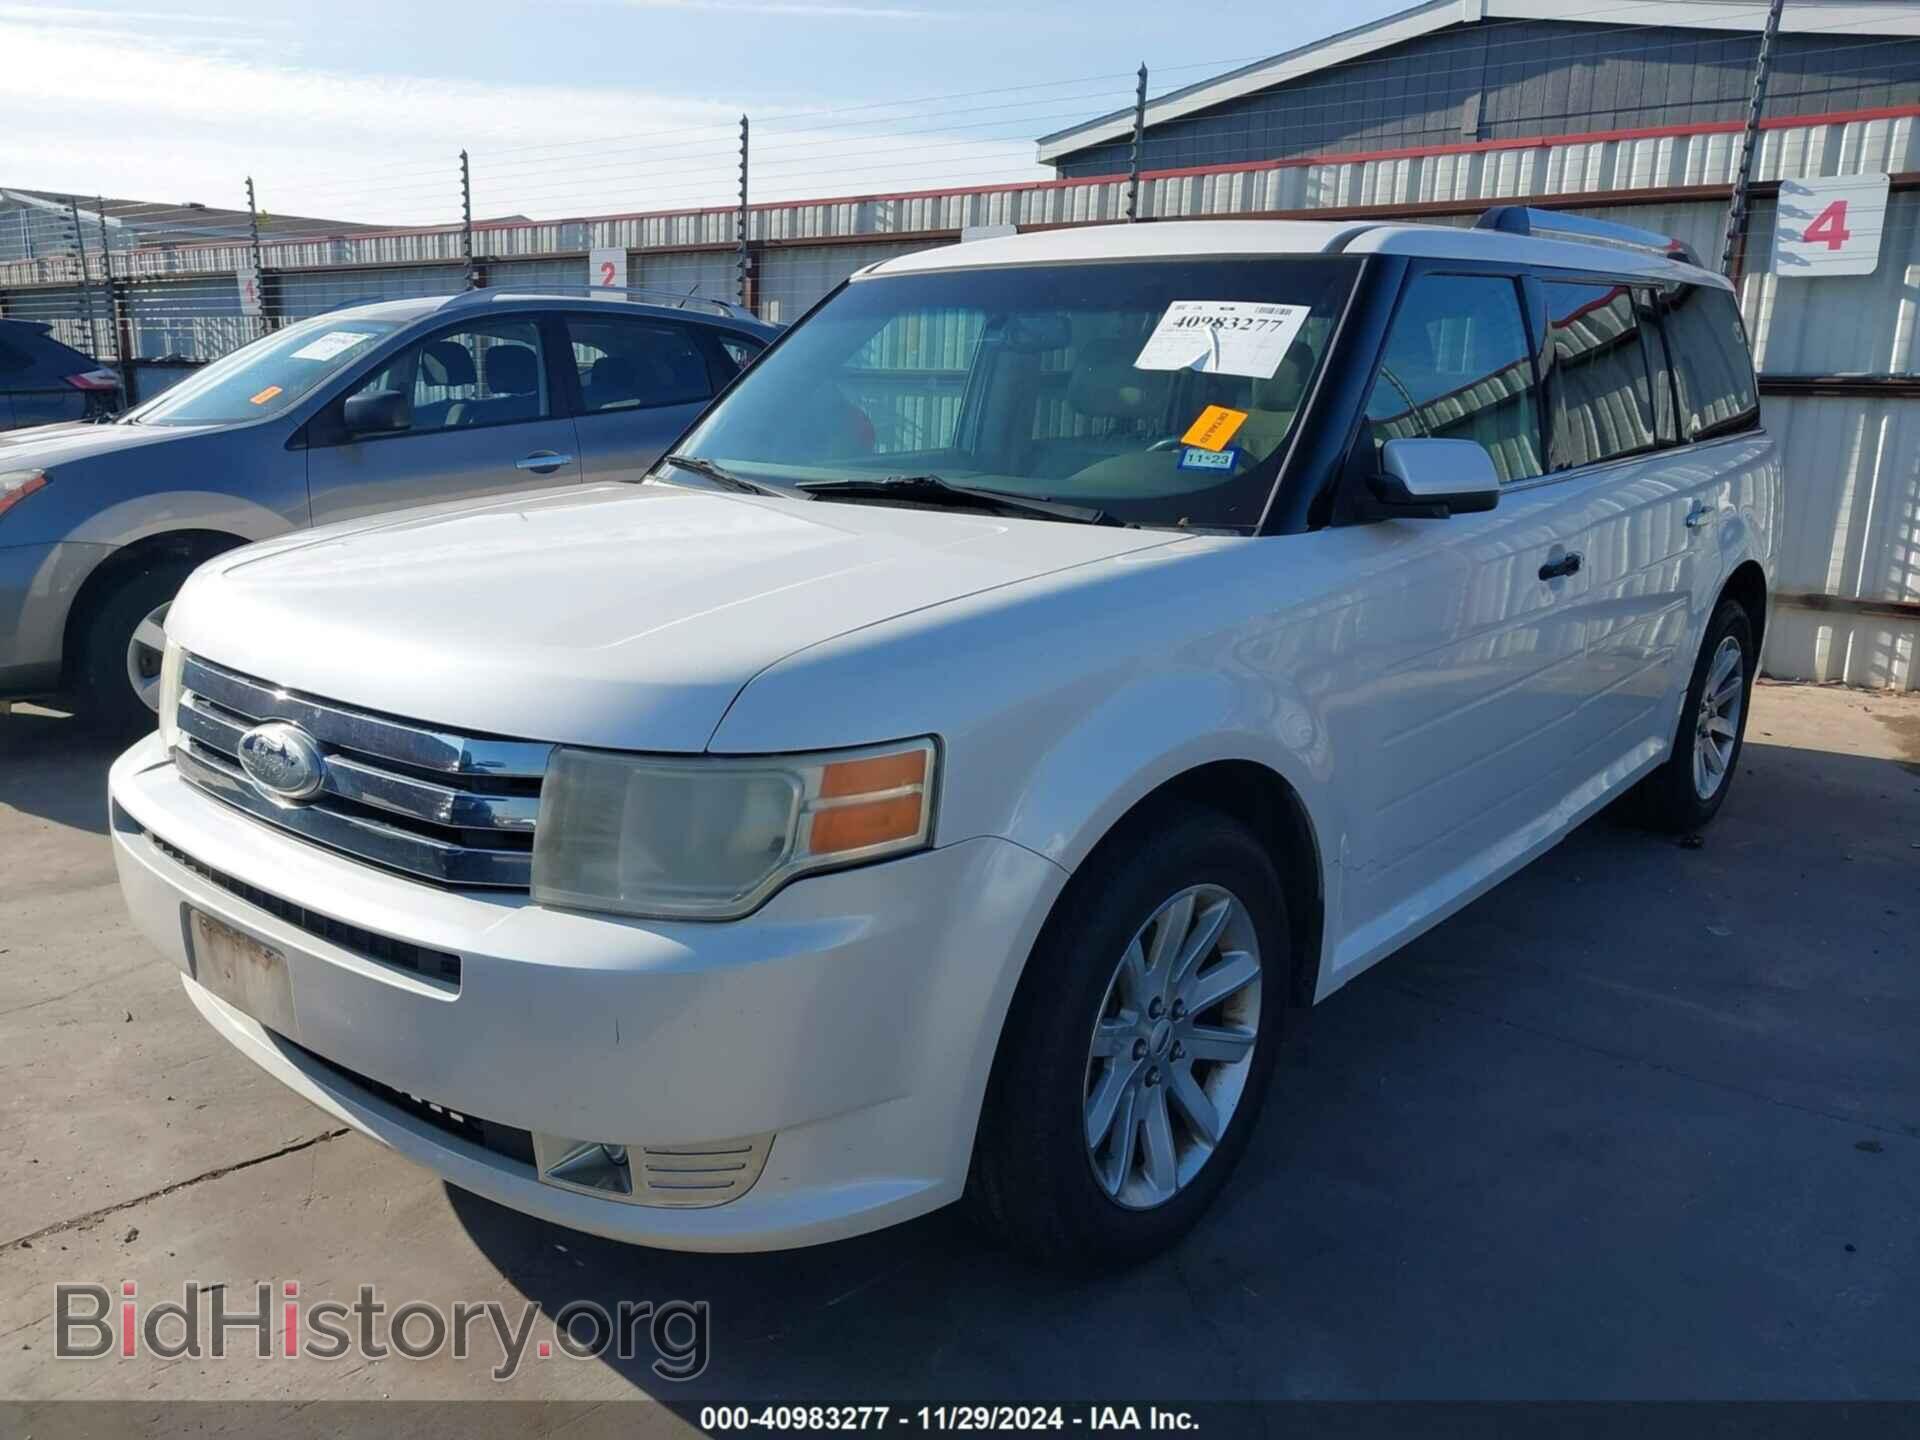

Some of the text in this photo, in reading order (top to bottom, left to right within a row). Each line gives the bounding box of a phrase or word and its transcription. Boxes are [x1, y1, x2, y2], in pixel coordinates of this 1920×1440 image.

[1803, 200, 1850, 250] 4
[601, 261, 616, 288] 2
[1173, 314, 1283, 333] 40983277
